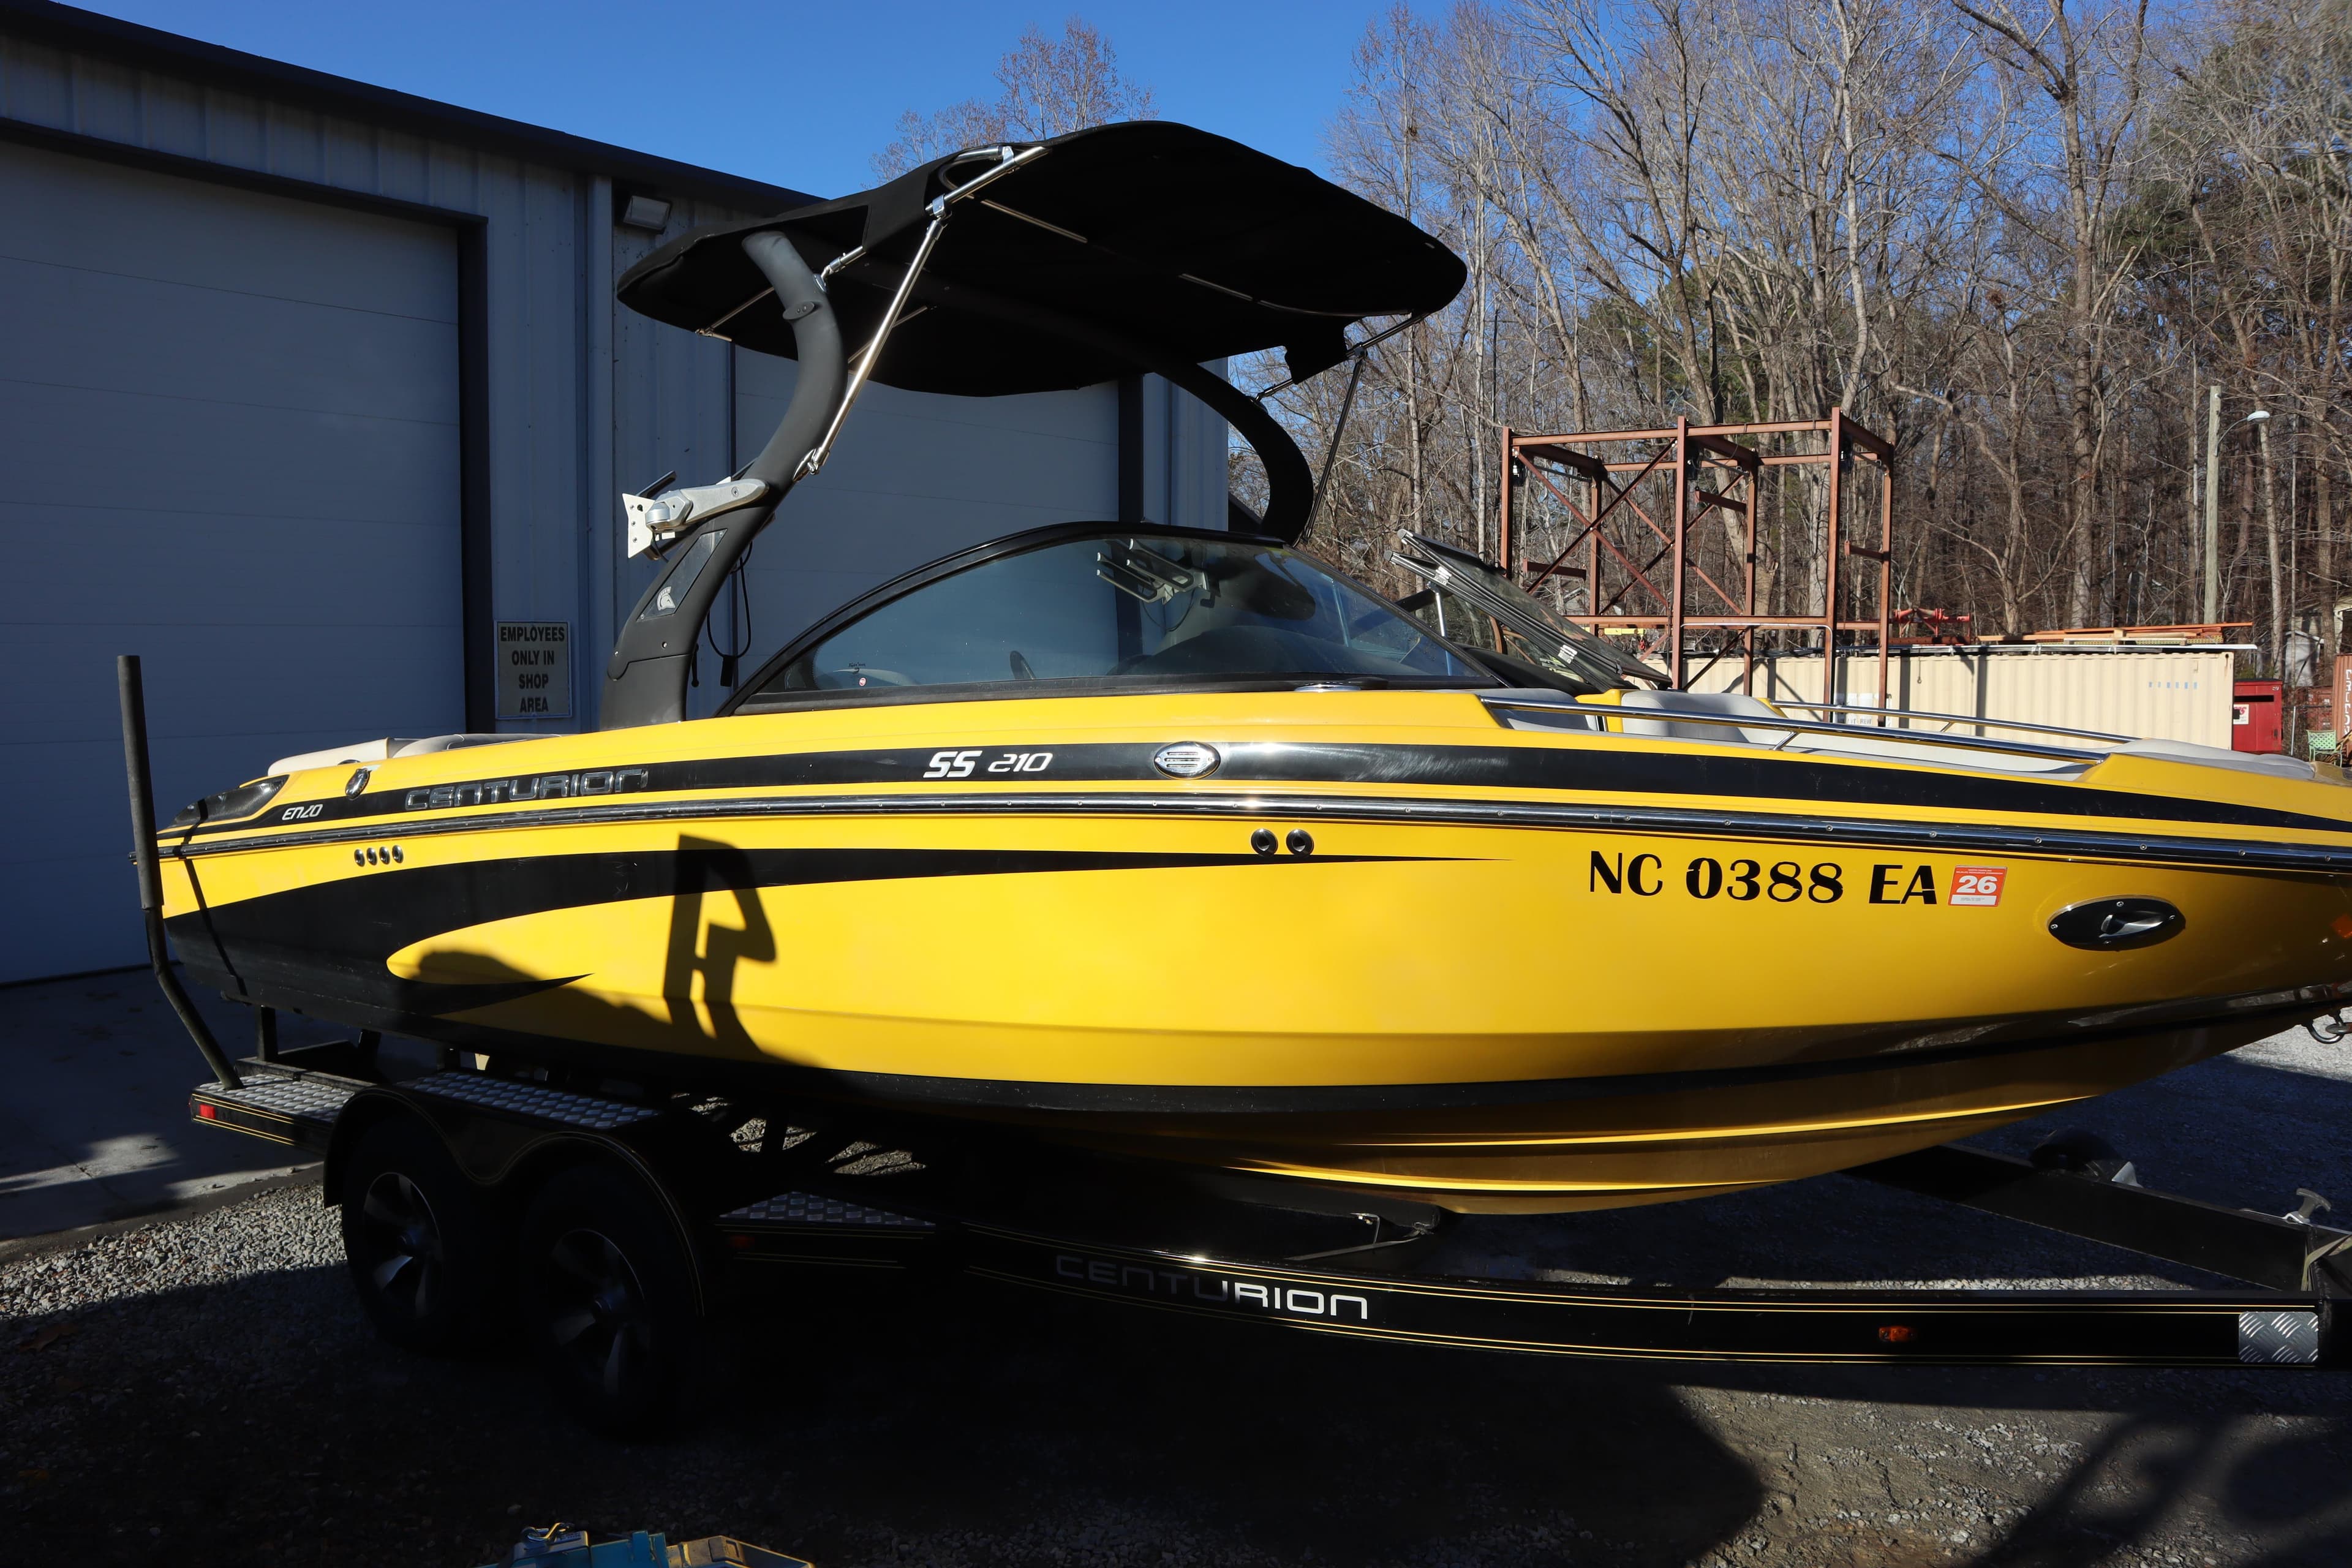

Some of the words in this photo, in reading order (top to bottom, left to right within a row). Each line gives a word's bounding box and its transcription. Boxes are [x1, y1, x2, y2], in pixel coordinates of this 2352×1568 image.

[500, 626, 565, 641] EMPLOYEES
[512, 650, 540, 666] ONLY
[543, 650, 555, 666] IN
[518, 673, 549, 689] SHOP
[520, 696, 549, 712] AREA
[923, 750, 982, 778] SS
[988, 753, 1053, 772] 210
[405, 768, 649, 810] CENTURION
[1590, 850, 1663, 896] NC
[1686, 857, 1843, 903] 0388
[1869, 864, 1937, 905] EA
[1956, 875, 1998, 894] 26
[1054, 1254, 1368, 1320] CENTURION
